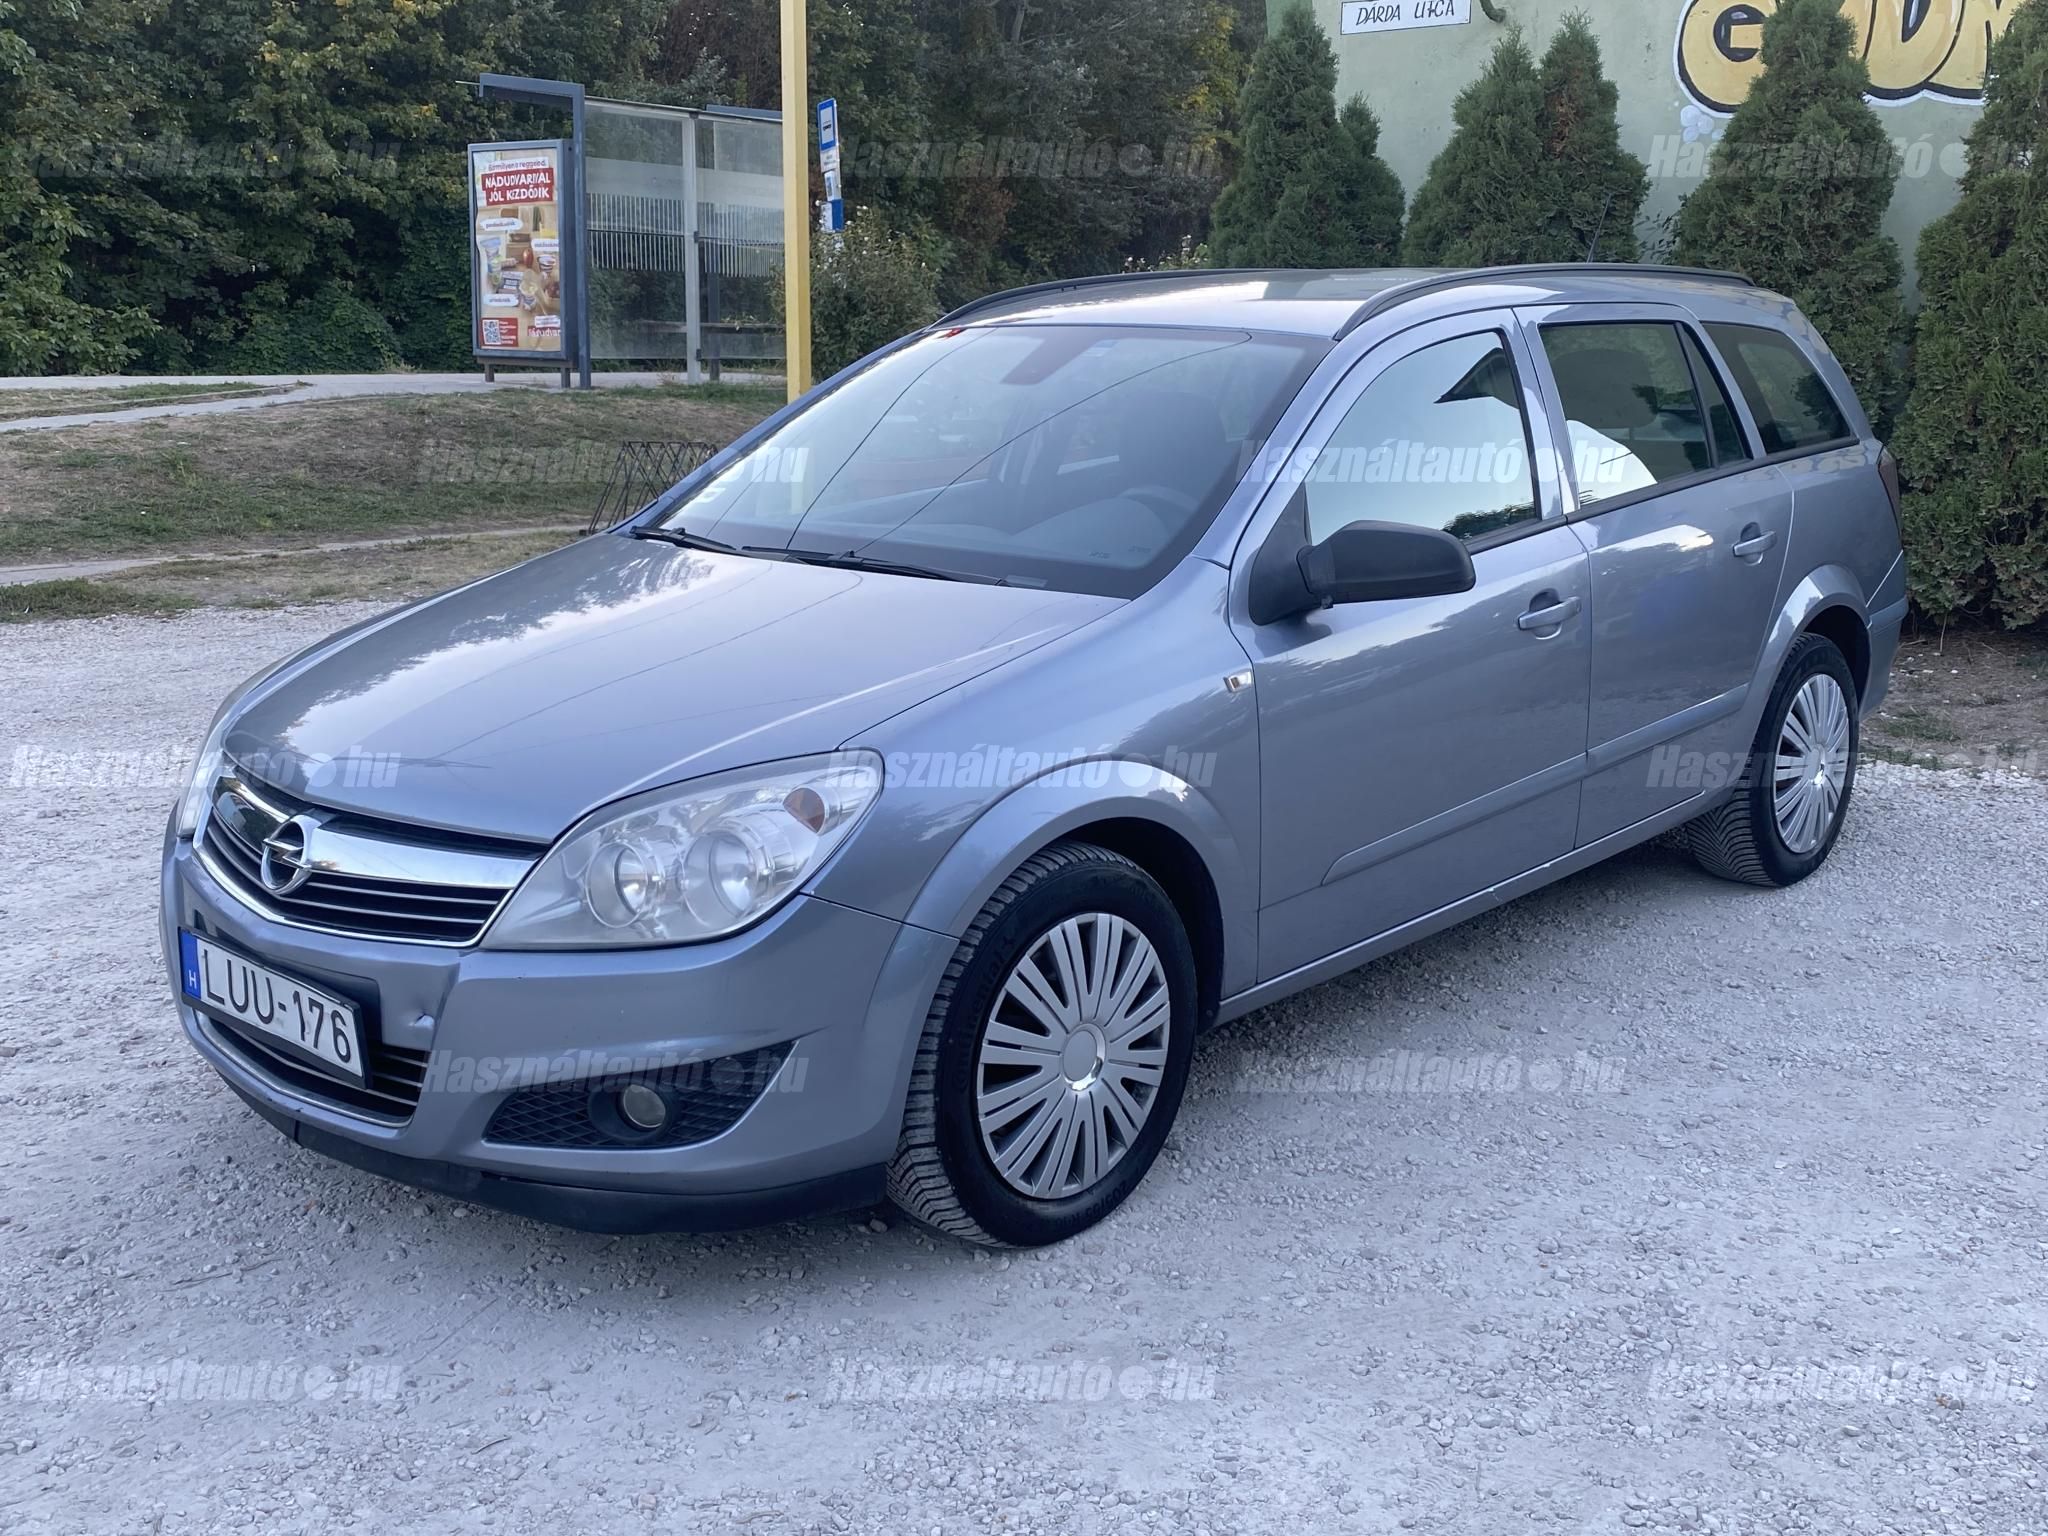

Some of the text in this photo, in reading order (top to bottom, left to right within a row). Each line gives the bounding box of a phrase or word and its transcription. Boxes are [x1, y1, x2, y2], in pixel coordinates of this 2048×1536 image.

[1355, 3, 1400, 26] DÁRDA
[485, 173, 551, 188] NÁDUDVARIVAL
[489, 188, 504, 202] JÓL
[188, 969, 197, 989] H
[203, 948, 351, 1064] LUU-176
